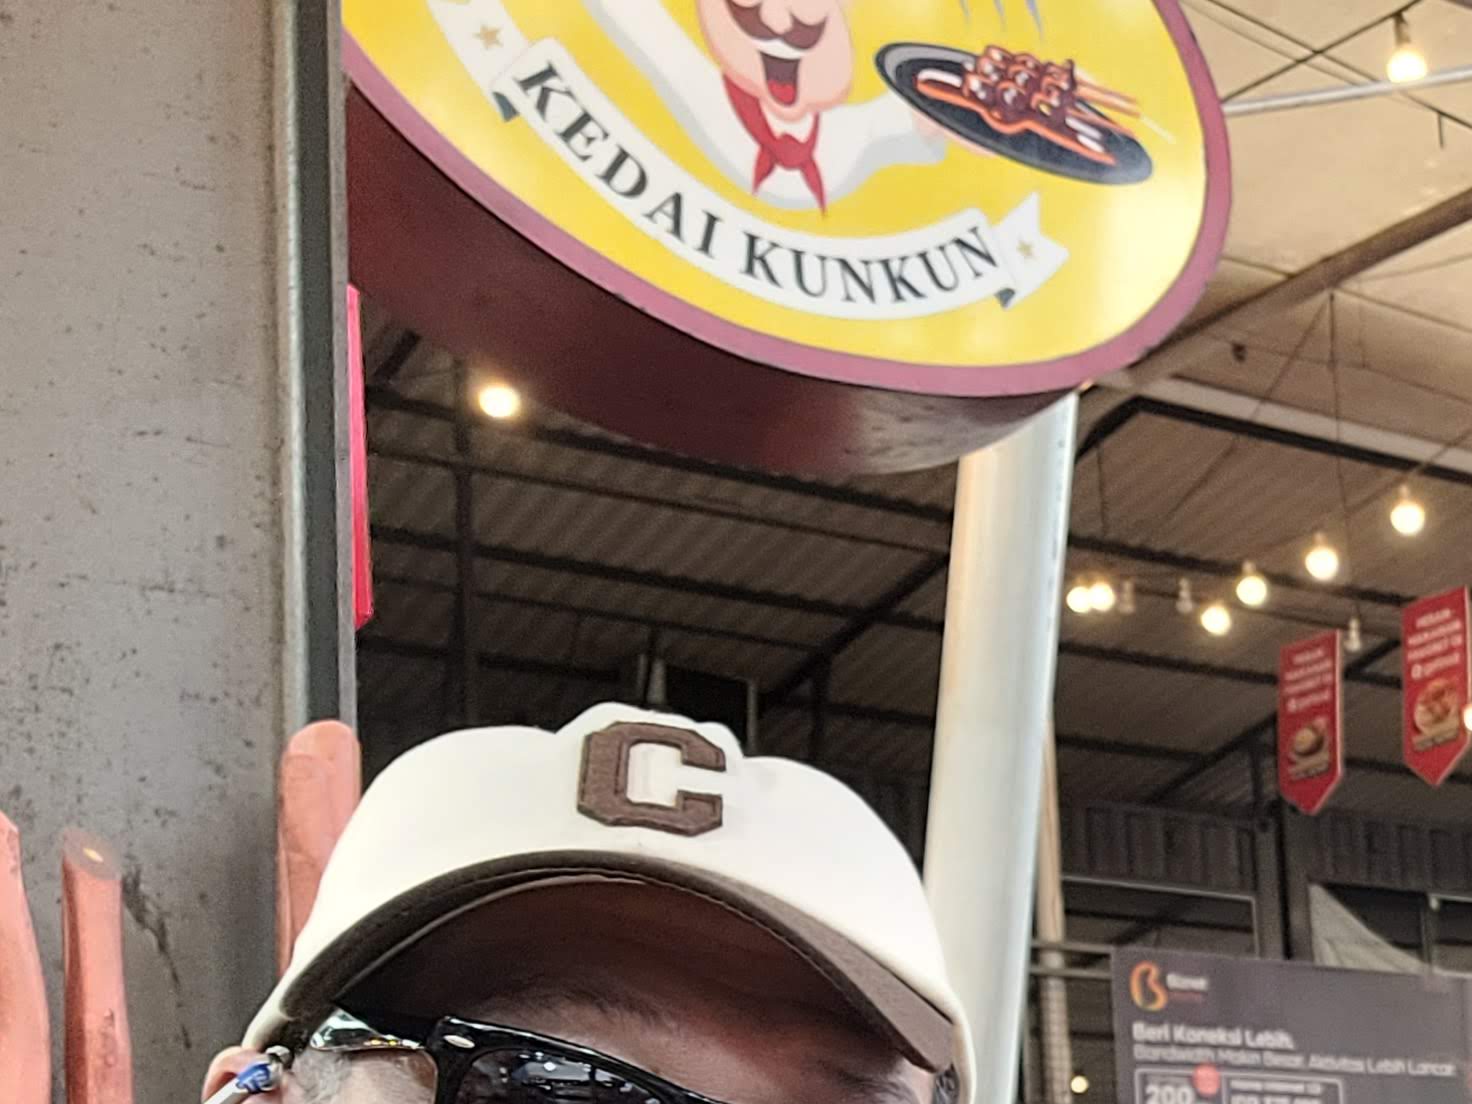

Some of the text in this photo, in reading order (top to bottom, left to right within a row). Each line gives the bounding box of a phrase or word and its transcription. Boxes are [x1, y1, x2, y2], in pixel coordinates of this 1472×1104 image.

[512, 60, 998, 304] KEDAI KUNKUN
[577, 721, 726, 837] C
